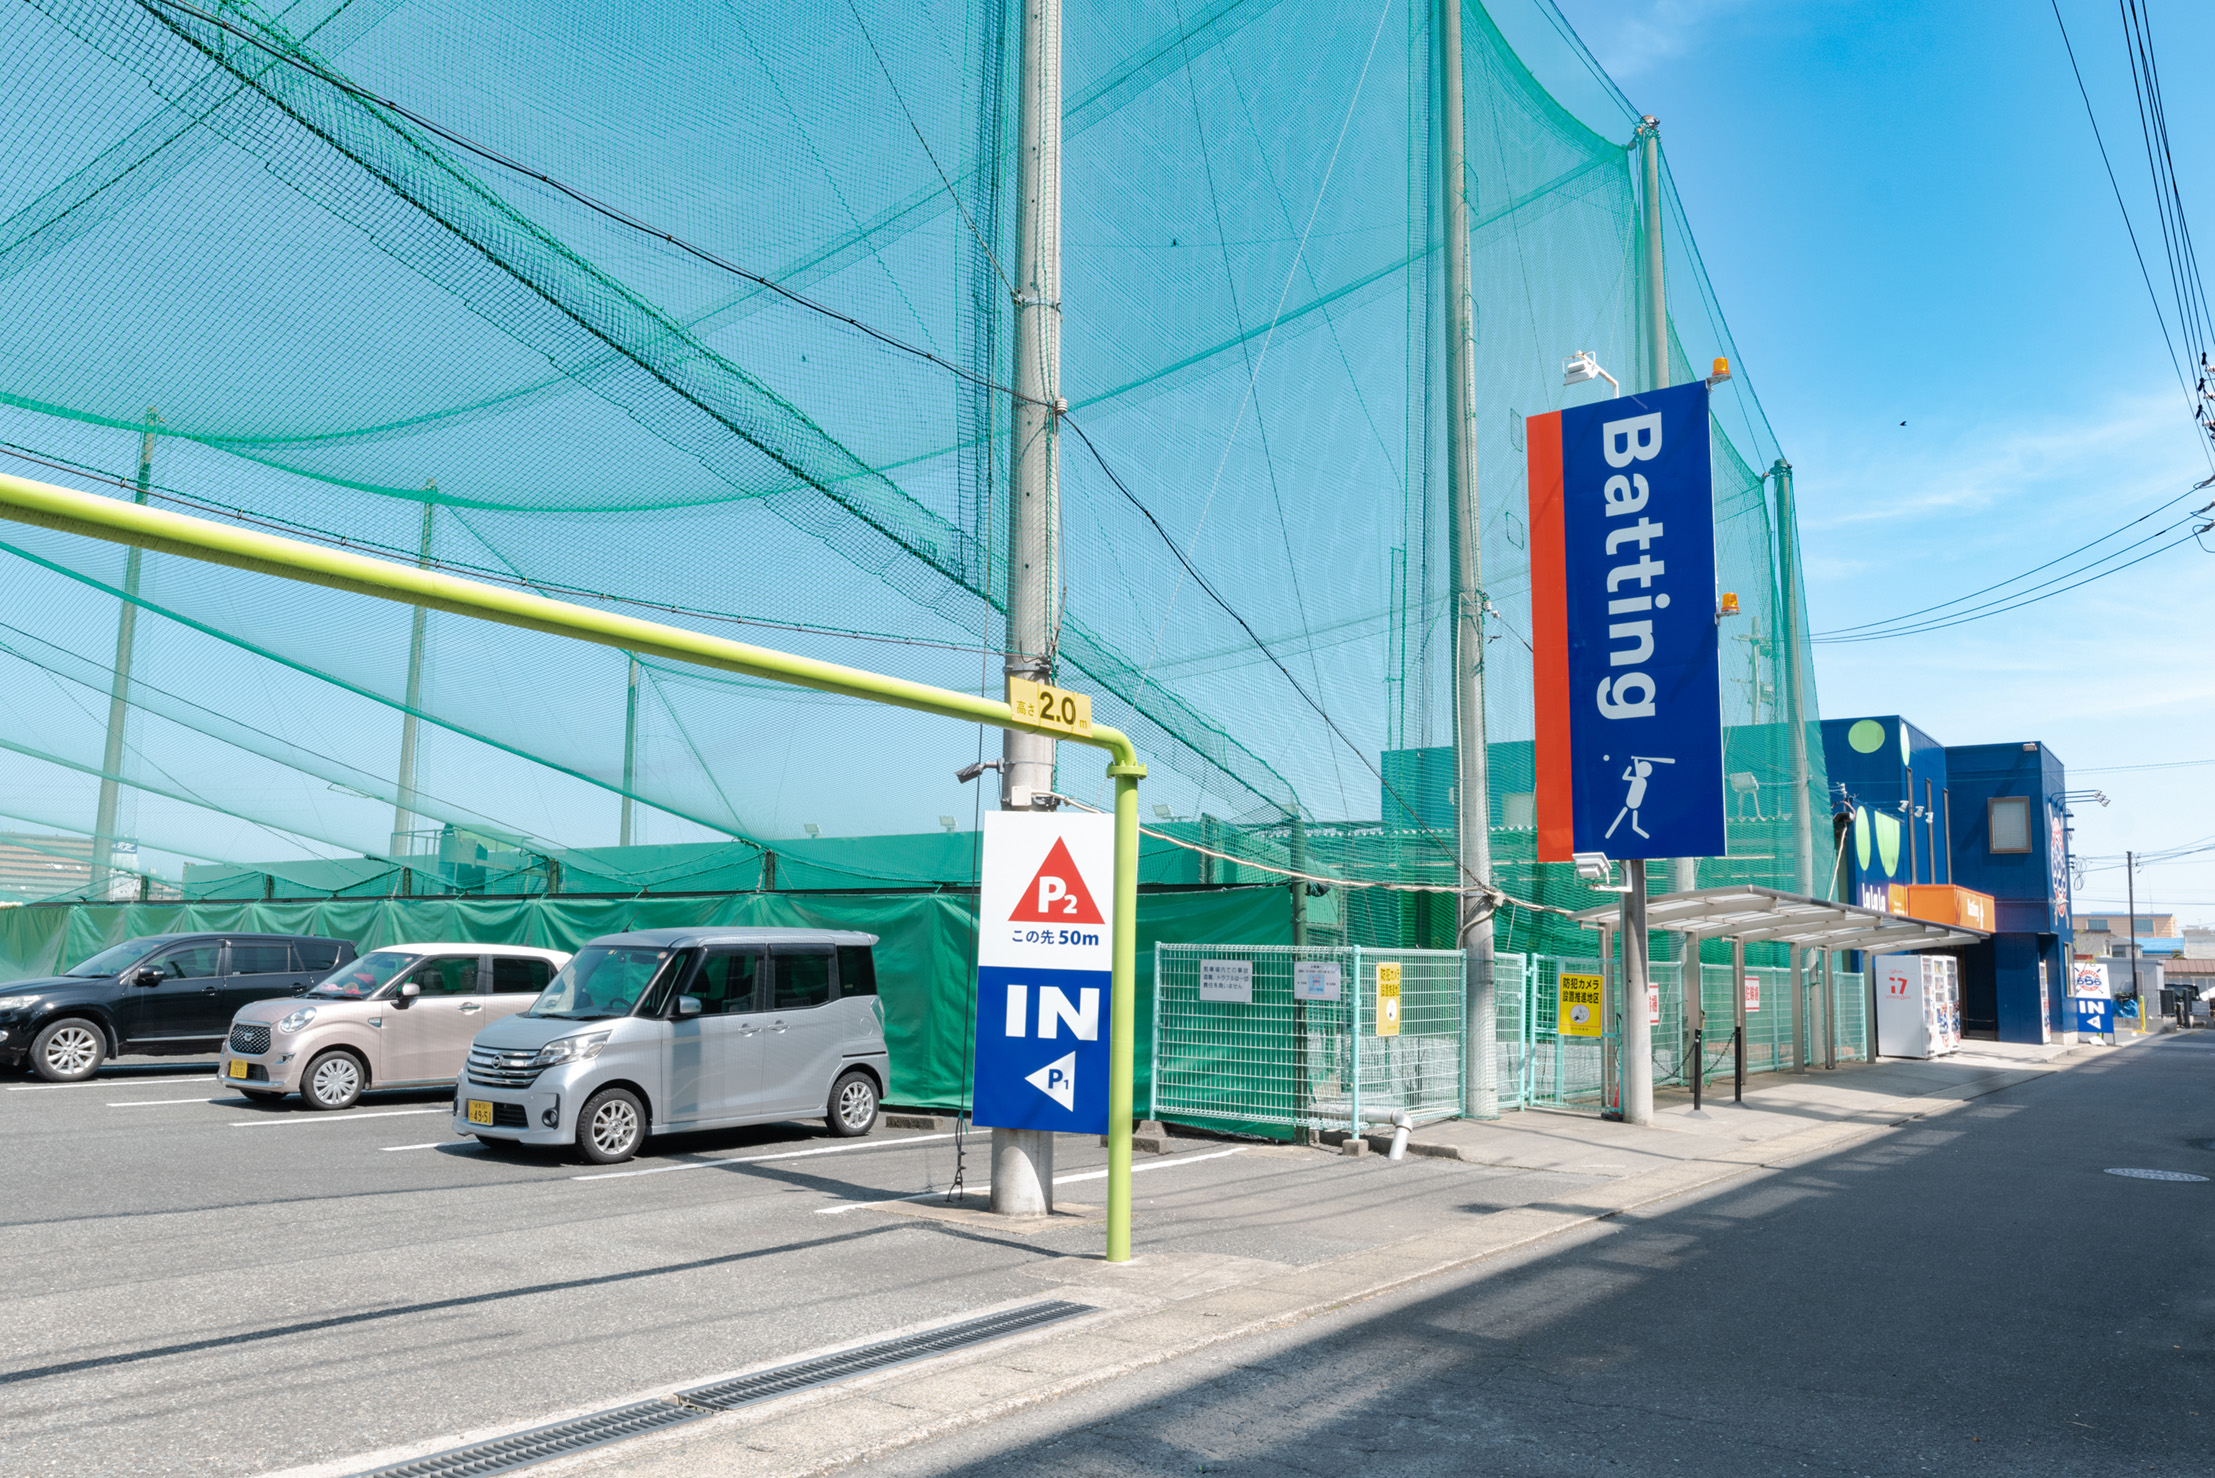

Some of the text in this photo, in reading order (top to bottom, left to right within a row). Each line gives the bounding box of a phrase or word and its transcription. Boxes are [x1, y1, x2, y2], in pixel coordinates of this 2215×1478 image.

[1596, 412, 1671, 720] Batting
[1016, 691, 1088, 729] 高さ 2.0 m
[1038, 875, 1078, 914] P2
[1012, 929, 1100, 946] この先 50m
[1563, 977, 1599, 990] 防犯カメラ
[1562, 990, 1599, 1004] 設置推進地区
[2079, 1000, 2105, 1014] IN
[1005, 984, 1100, 1041] IN
[1048, 1068, 1069, 1090] P1
